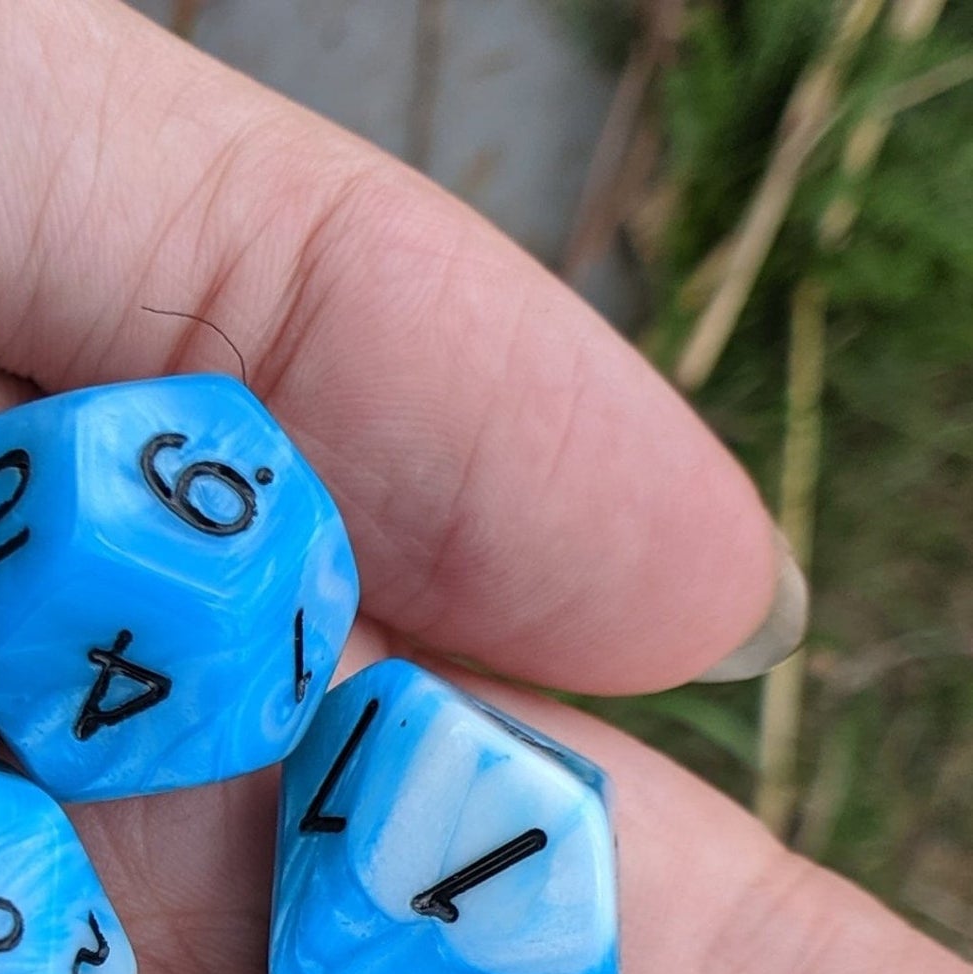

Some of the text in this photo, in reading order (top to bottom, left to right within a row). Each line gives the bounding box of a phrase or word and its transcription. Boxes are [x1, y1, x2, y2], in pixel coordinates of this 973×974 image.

[72, 629, 173, 743] 4
[294, 607, 313, 704] 1
[410, 827, 548, 924] 1
